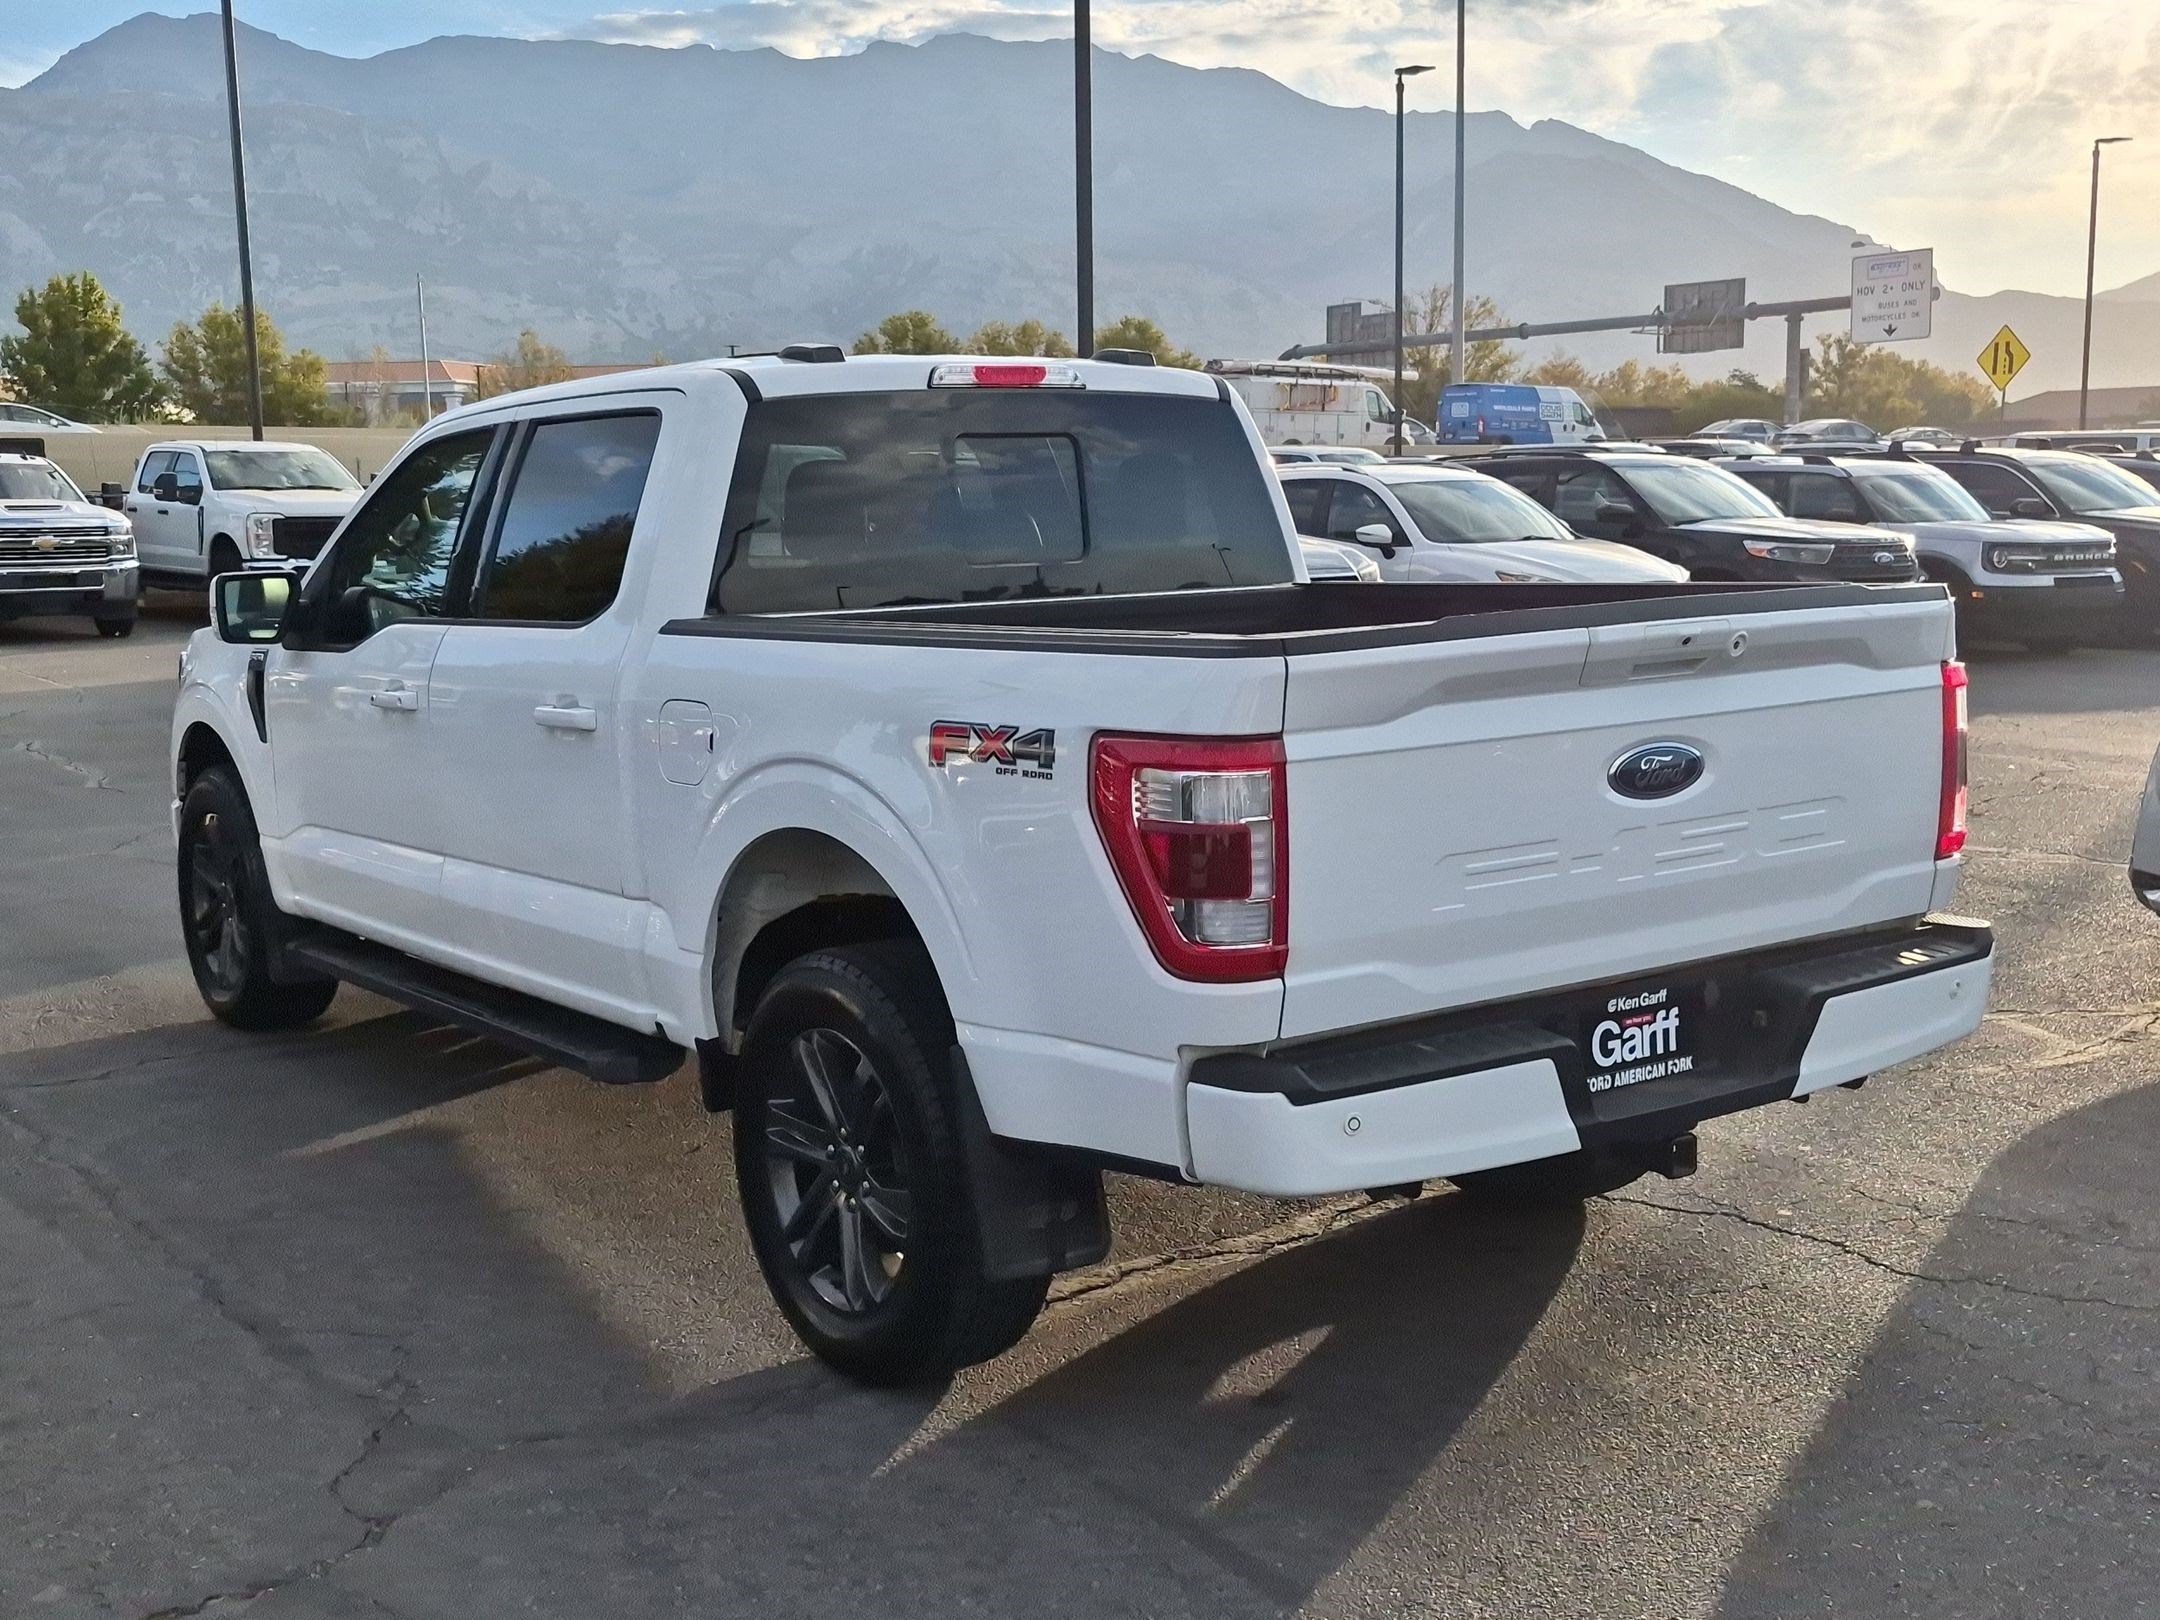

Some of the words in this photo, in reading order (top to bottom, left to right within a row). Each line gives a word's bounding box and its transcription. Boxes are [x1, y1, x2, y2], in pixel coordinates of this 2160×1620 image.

[1857, 285, 1875, 296] HOV
[1882, 284, 1894, 294] 2+
[1901, 280, 1926, 292] ONLY
[1878, 301, 1899, 309] BUSES
[1861, 312, 1907, 322] MOTORCYCLES
[928, 719, 1056, 770] FX4
[995, 767, 1018, 776] OFF
[1022, 770, 1054, 780] ROAD
[1617, 996, 1639, 1011] Ken
[1640, 988, 1668, 1006] Garff
[1591, 1007, 1680, 1068] Garff
[1587, 1074, 1611, 1093] ORD
[1614, 1062, 1666, 1088] AMERICAN
[1667, 1056, 1693, 1076] FORK
